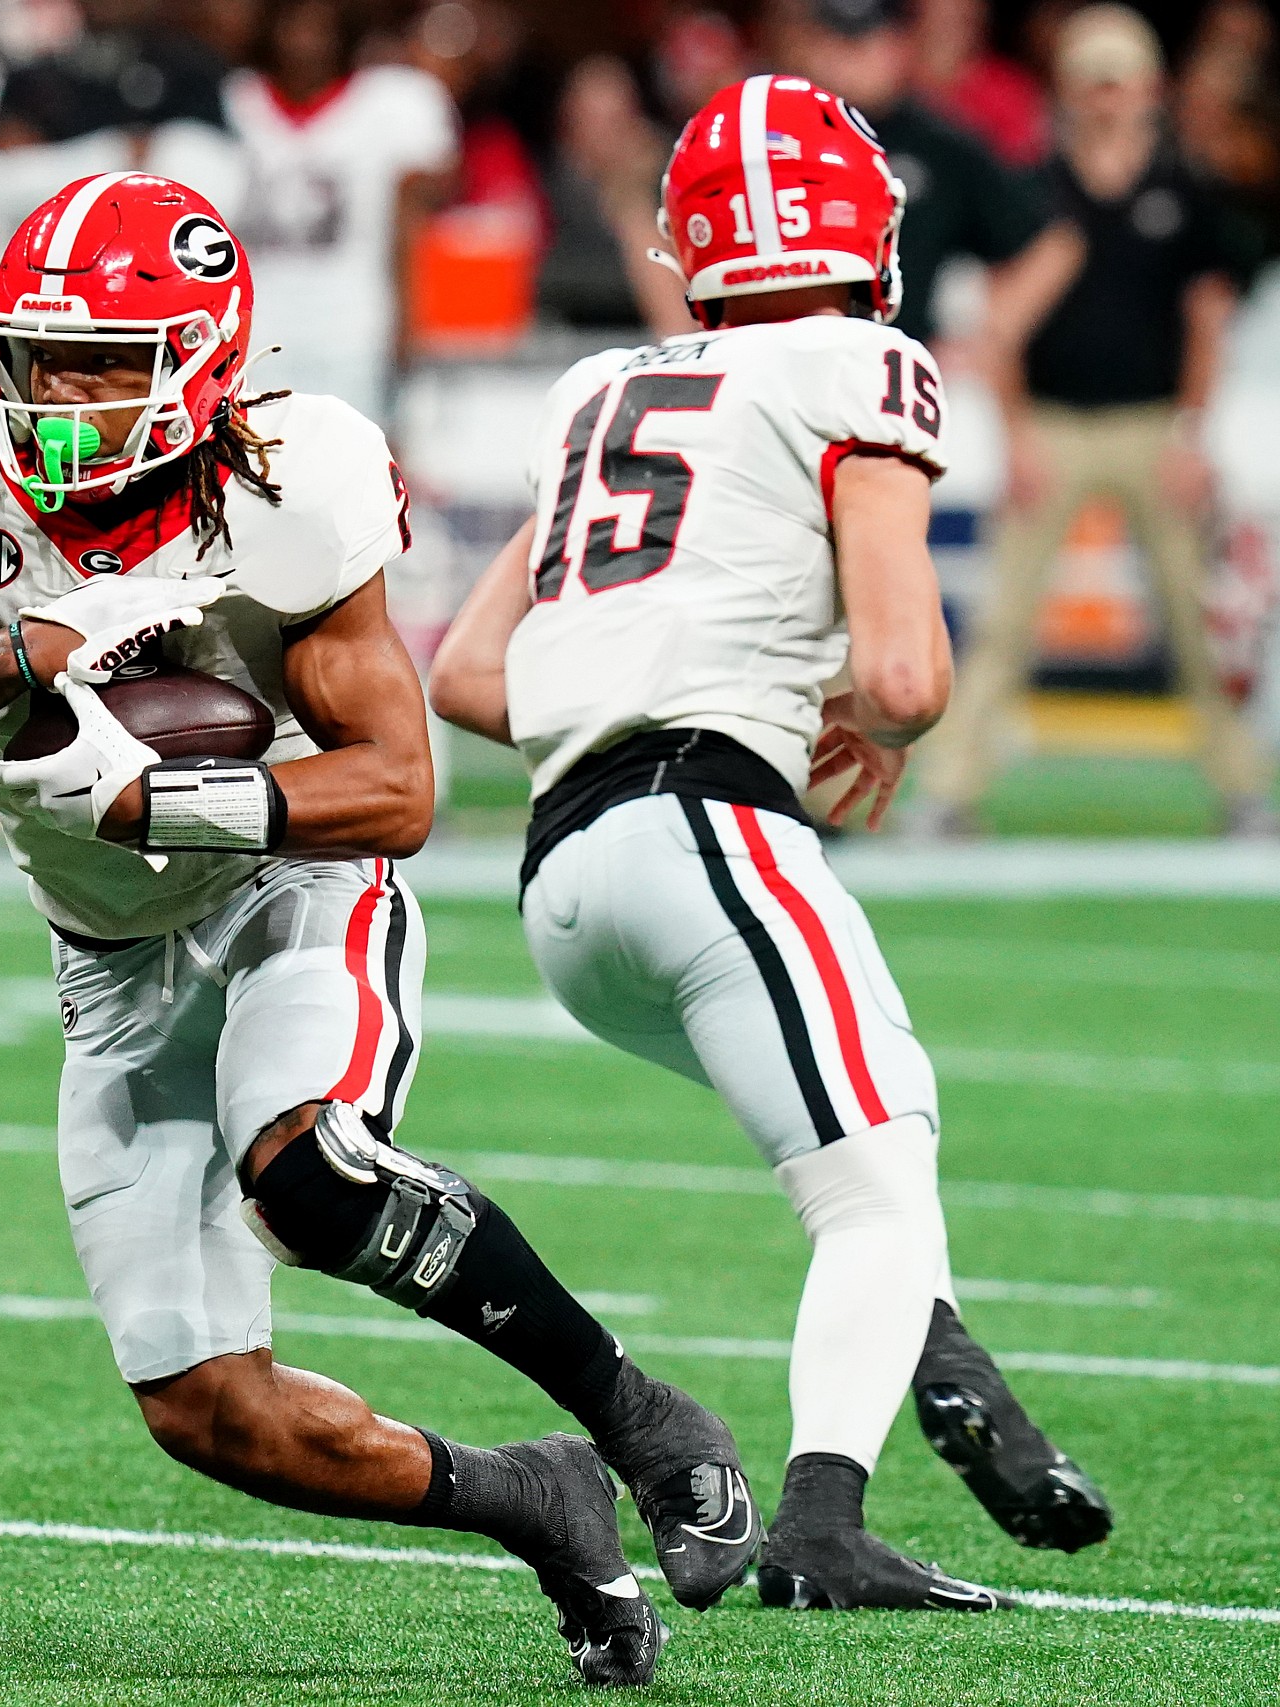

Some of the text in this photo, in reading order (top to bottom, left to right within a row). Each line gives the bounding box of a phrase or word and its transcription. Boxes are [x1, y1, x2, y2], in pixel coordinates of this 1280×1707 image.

[729, 187, 811, 244] 15
[173, 216, 236, 278] G
[722, 260, 831, 286] GEORGIA
[880, 348, 941, 440] 15
[534, 373, 726, 604] 15
[81, 550, 122, 573] G
[89, 617, 187, 672] ORGIA
